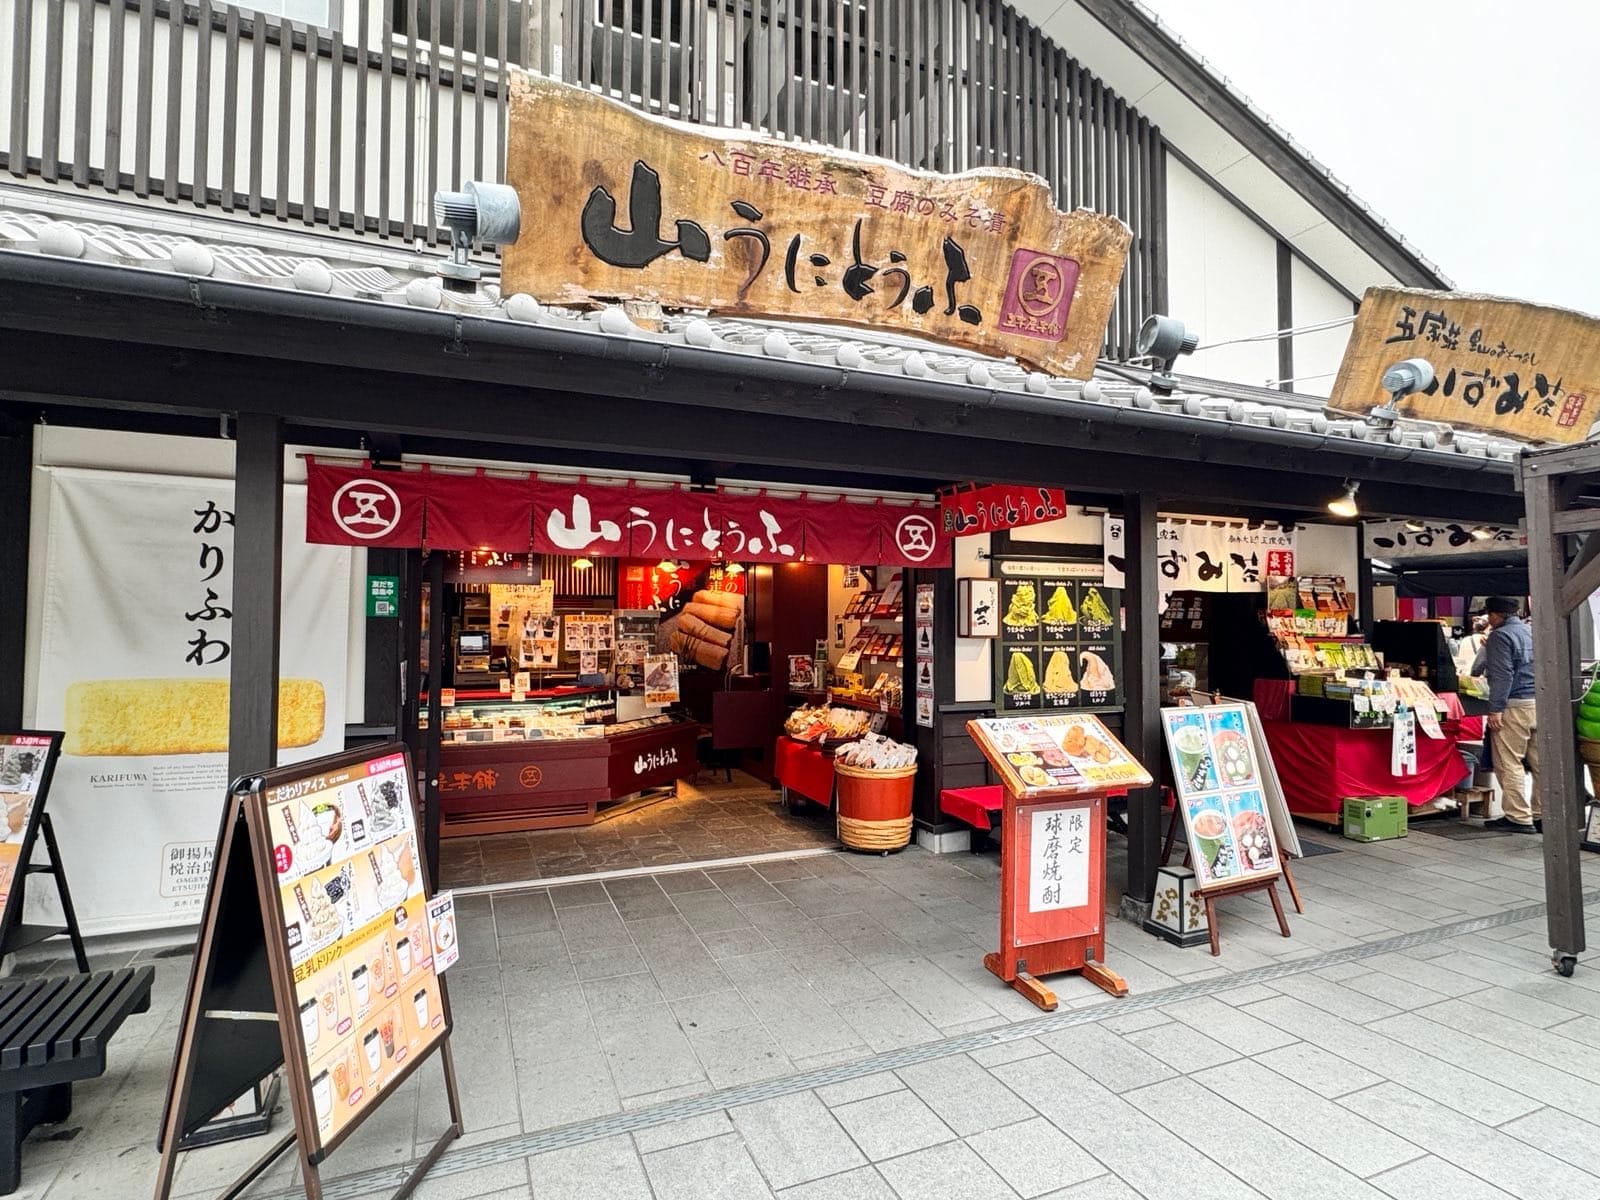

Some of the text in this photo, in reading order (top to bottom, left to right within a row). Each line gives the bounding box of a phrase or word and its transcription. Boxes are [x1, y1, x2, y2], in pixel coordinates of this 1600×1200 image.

[700, 149, 1007, 234] 八百年継承 豆腐のみそ漬
[581, 159, 983, 327] 山うにとうふ
[547, 494, 795, 556] 山うにとうふ
[185, 501, 236, 666] かりふわ
[90, 773, 147, 783] KARIFUWA
[266, 779, 328, 802] こだわりアイス
[1042, 813, 1063, 905] 球磨焼酎
[1068, 815, 1084, 854] 限定
[294, 945, 343, 981] 豆乳ドリンク
